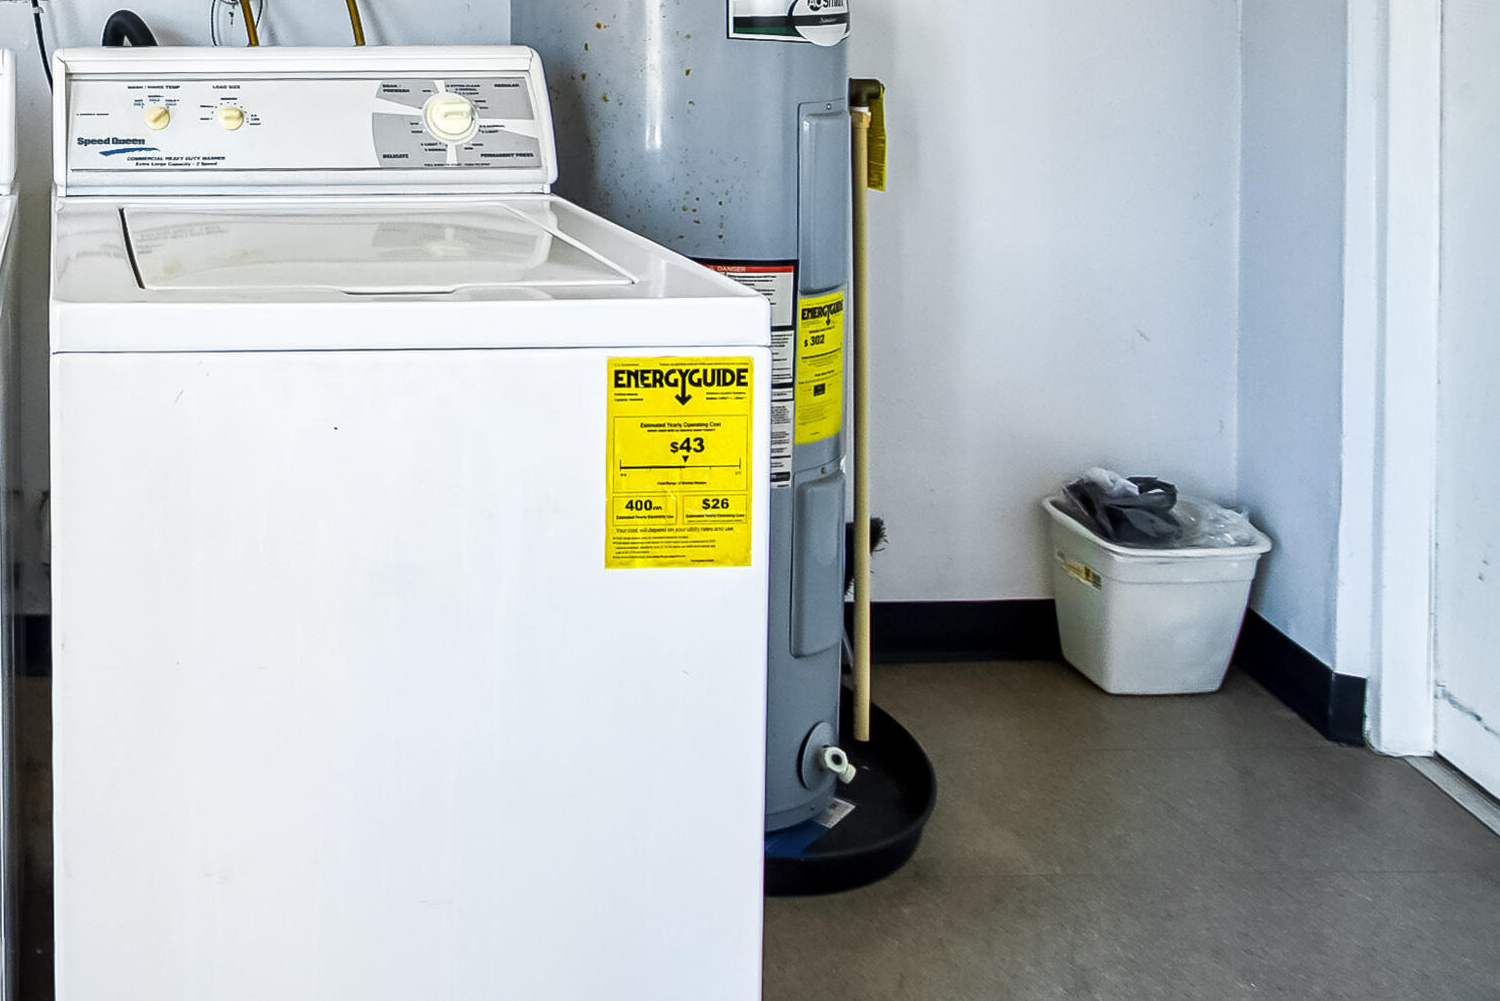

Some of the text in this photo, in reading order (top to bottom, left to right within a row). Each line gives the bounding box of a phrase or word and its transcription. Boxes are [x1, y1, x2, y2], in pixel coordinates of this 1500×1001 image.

[77, 137, 146, 147] Speed Queen
[809, 334, 826, 347] 302
[613, 367, 749, 389] ENERGYGUIDE
[669, 436, 706, 454] $43
[624, 498, 653, 512] 400
[701, 497, 730, 511] $26
